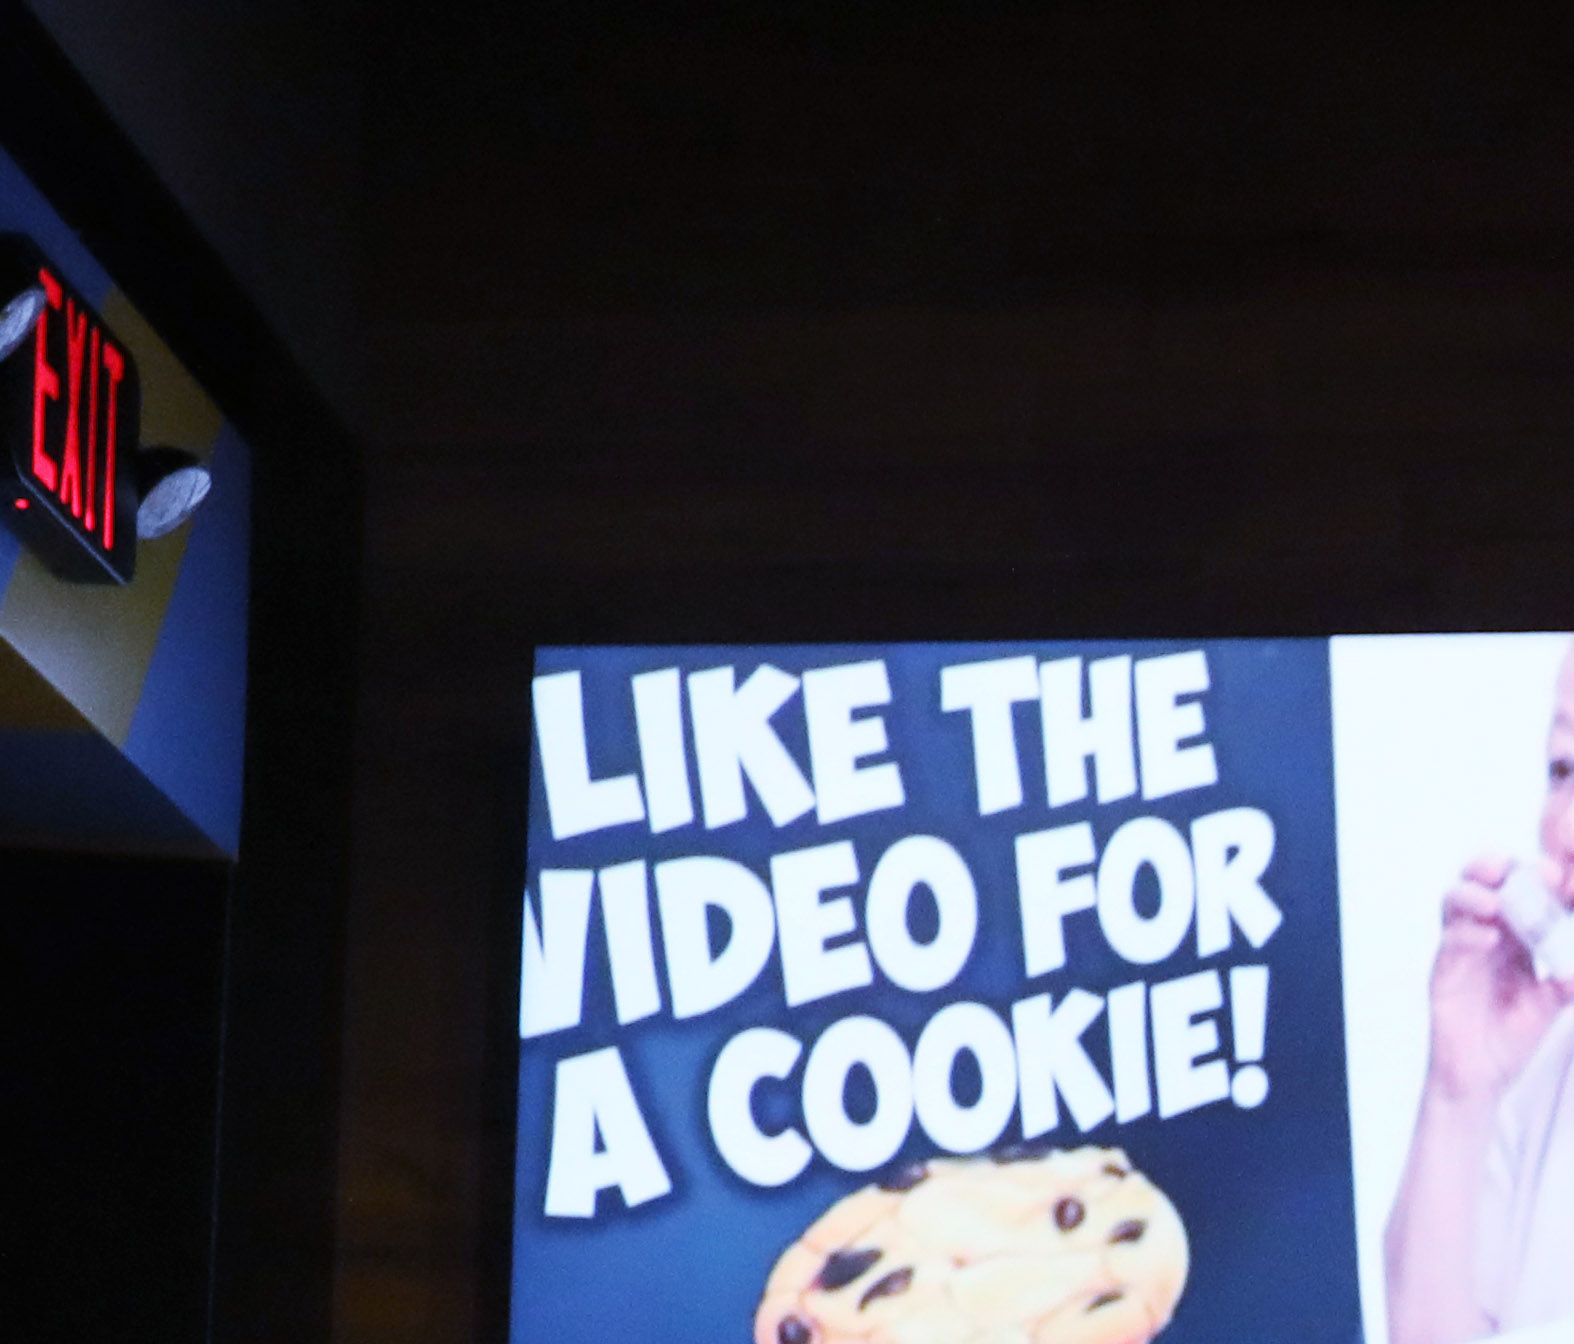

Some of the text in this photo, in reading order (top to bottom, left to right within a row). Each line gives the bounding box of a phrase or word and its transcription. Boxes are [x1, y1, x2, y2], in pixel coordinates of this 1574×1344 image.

[32, 267, 124, 551] EXIT
[533, 651, 1217, 840] LIKE THE
[1015, 806, 1283, 978] FOR
[544, 965, 1270, 1218] A COOKIE!
